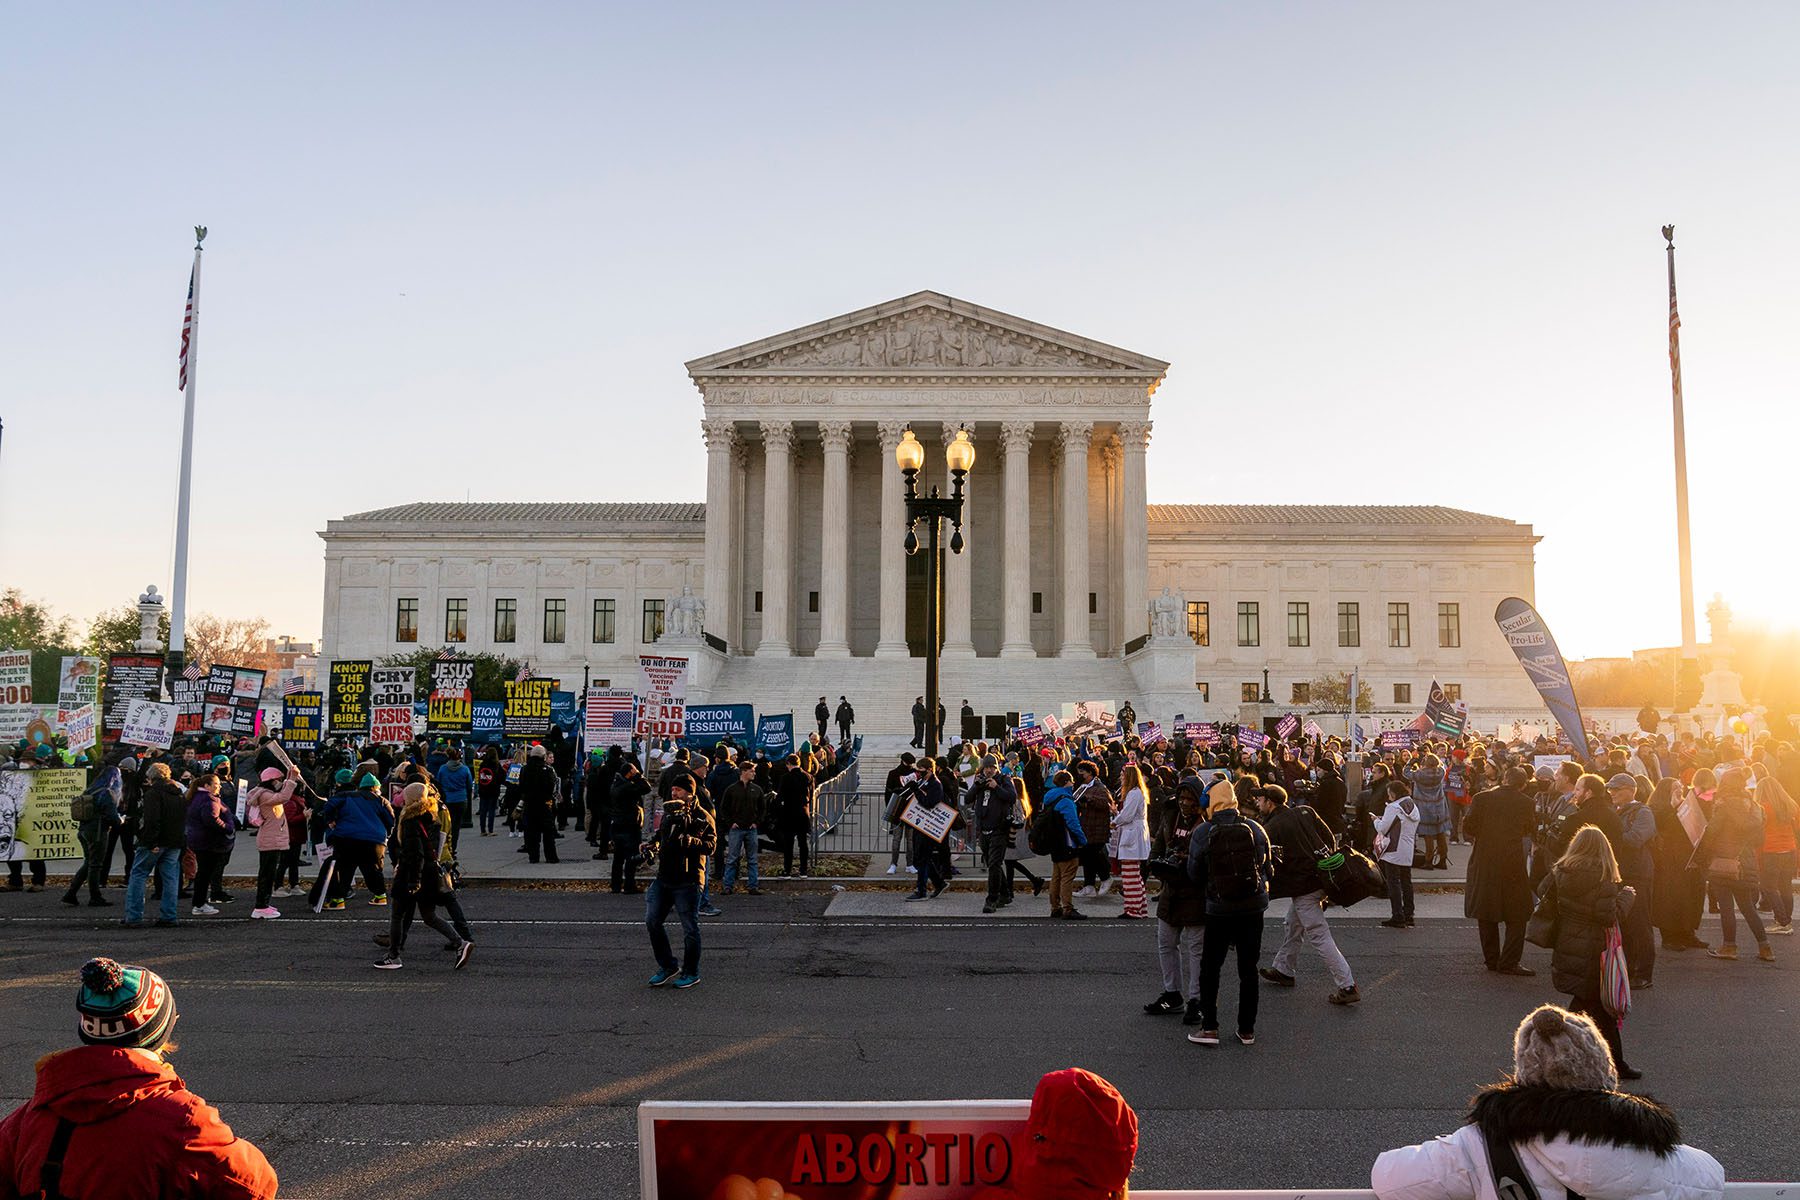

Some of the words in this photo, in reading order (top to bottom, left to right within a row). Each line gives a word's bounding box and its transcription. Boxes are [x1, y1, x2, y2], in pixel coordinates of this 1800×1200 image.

[1502, 614, 1532, 632] Secular
[1510, 634, 1544, 645] Pro-Life
[0, 655, 30, 667] MERICA
[222, 670, 233, 678] you
[333, 664, 369, 673] KNOW
[432, 663, 473, 679] JESUS
[210, 676, 232, 685] choose
[340, 674, 362, 683] THE
[373, 671, 414, 683] CRY
[174, 681, 188, 691] GOD
[189, 679, 208, 691] HATE
[208, 683, 231, 694] LIFE?
[337, 684, 365, 693] GOD
[383, 685, 403, 693] TO
[435, 678, 468, 689] SAVES
[438, 689, 464, 698] FROM
[504, 681, 551, 698] TRUST
[174, 691, 194, 703] HANDS
[195, 690, 205, 702] TH
[228, 696, 239, 705] OR
[285, 695, 321, 707] TURN
[342, 694, 358, 703] OF
[373, 693, 412, 705] GOD
[297, 707, 318, 715] JESUS
[340, 704, 361, 712] THE
[431, 699, 469, 719] HELL
[504, 699, 550, 716] JESUS
[638, 705, 683, 720] FAR
[333, 714, 367, 723] BIBLE
[373, 708, 411, 724] JESUS
[686, 710, 732, 720] BORTION
[294, 717, 309, 727] OR
[637, 720, 683, 735] GOD
[689, 721, 746, 732] ESSENTIAL
[284, 729, 319, 740] BURN
[371, 726, 413, 742] SAVES
[296, 741, 315, 749] HELL
[41, 810, 65, 819] rights
[32, 820, 79, 831] NOW's
[40, 833, 70, 844] THE
[33, 847, 75, 858] TIME!
[791, 1132, 1011, 1184] ABORTIO
